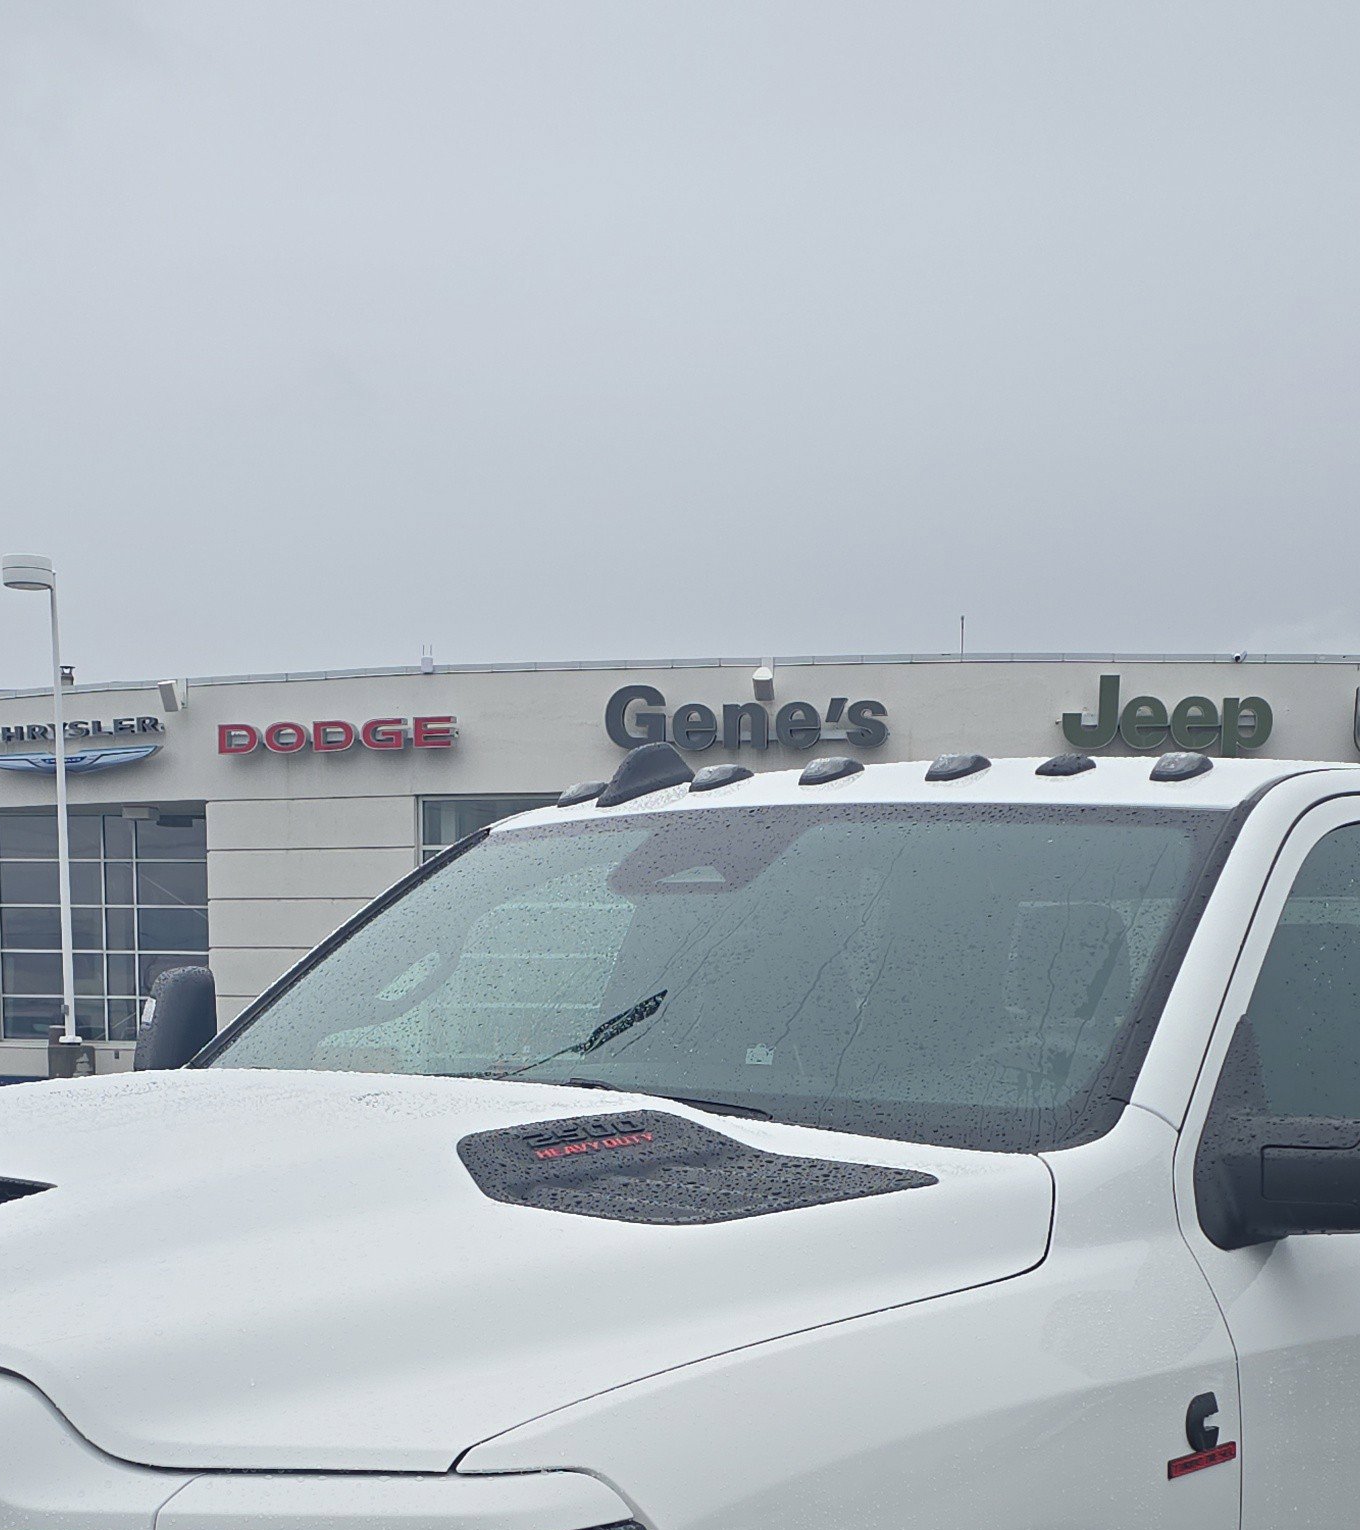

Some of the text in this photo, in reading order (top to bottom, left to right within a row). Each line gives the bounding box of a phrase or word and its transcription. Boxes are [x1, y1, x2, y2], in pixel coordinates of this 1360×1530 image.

[217, 715, 456, 755] DODGE
[605, 684, 889, 751] Gene's
[1062, 674, 1273, 757] Jeep
[534, 1131, 654, 1160] HEAVY DUTY
